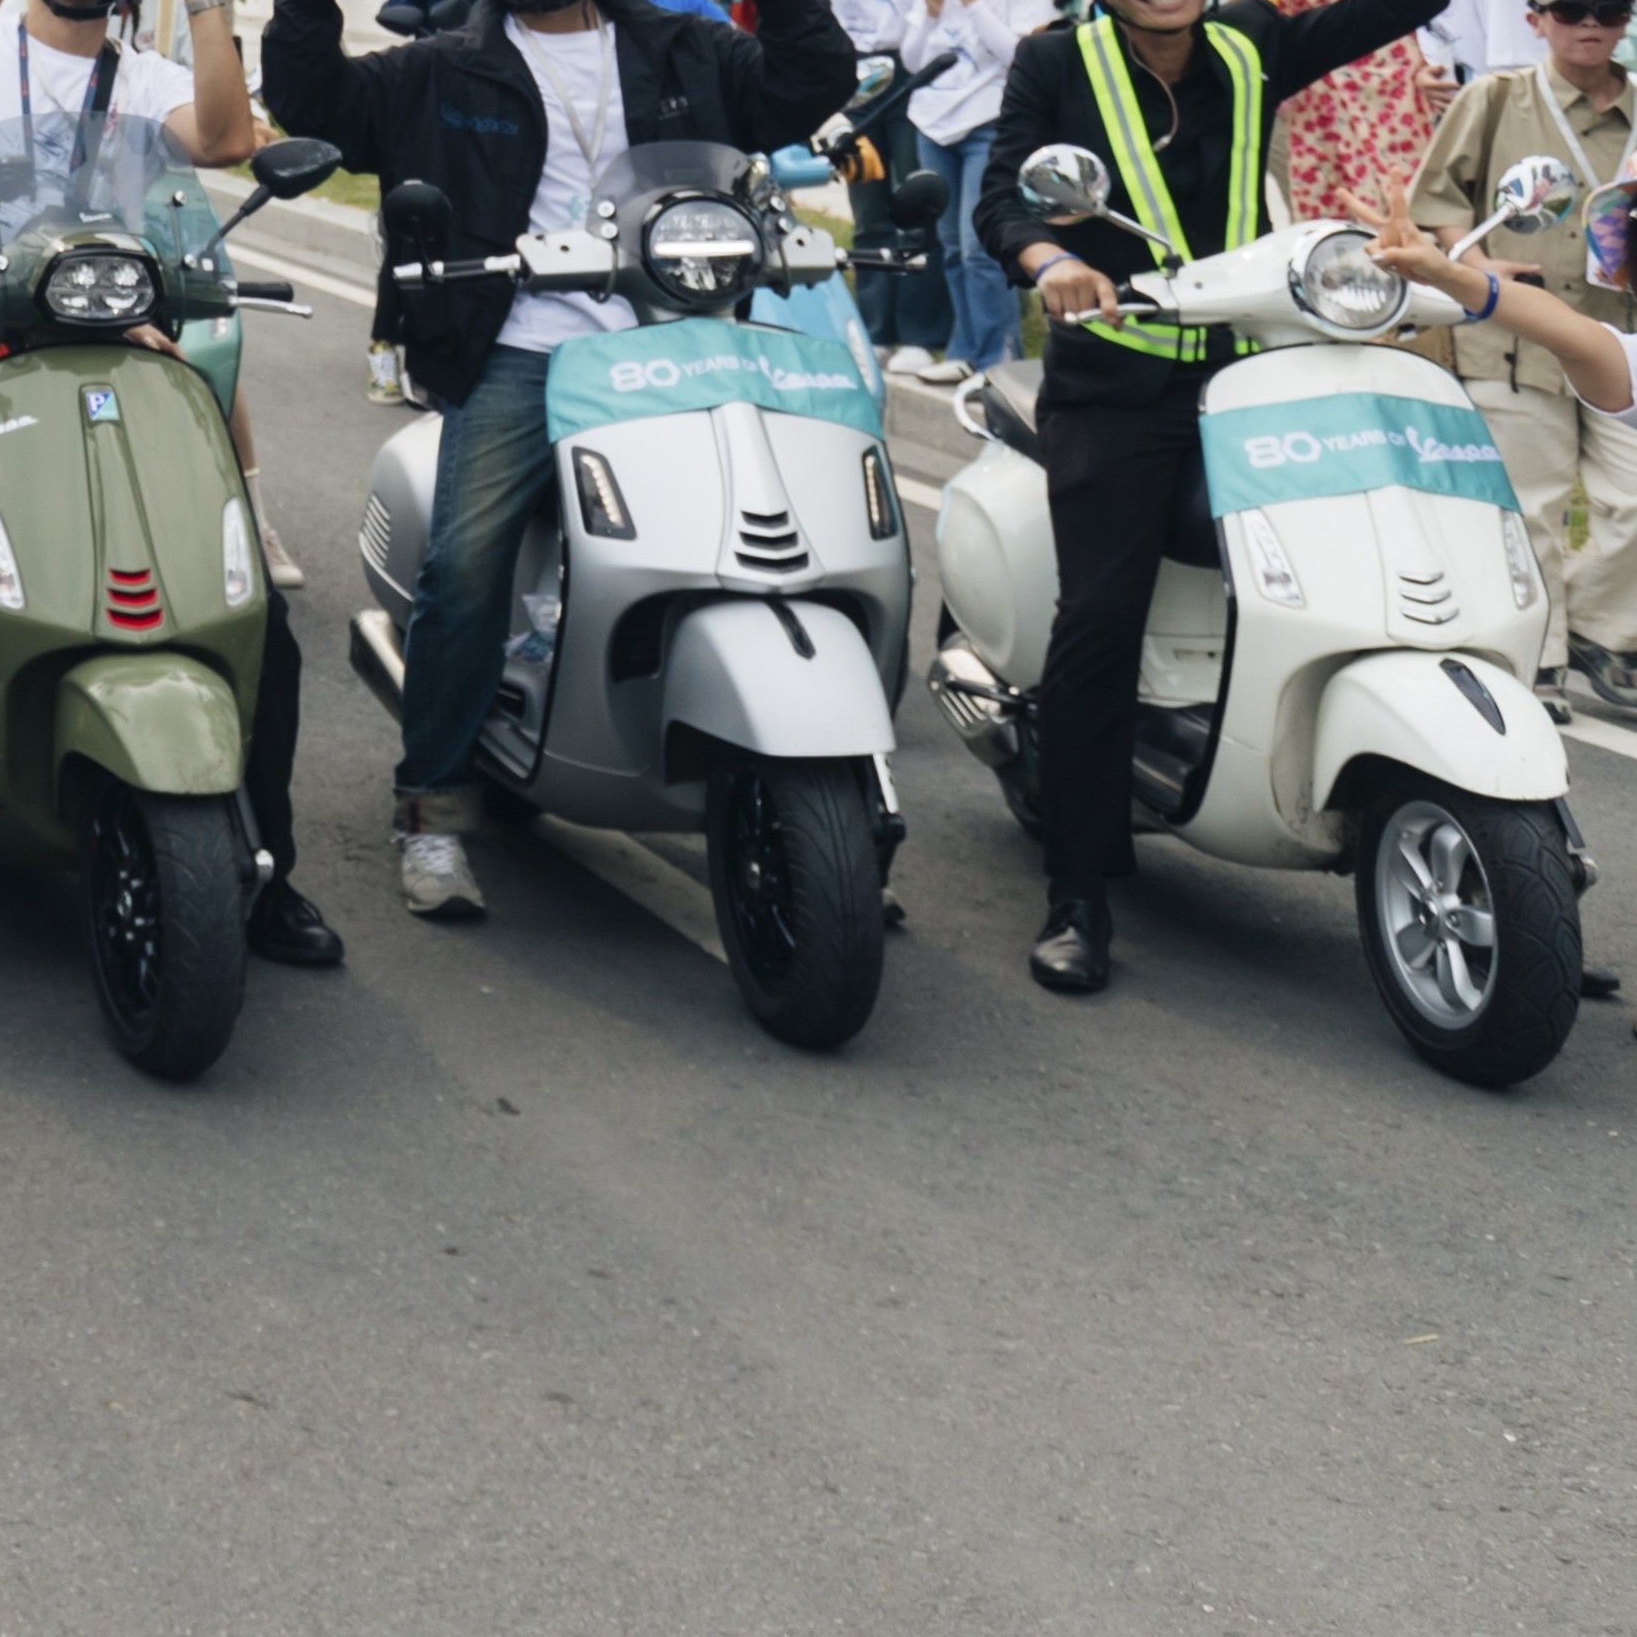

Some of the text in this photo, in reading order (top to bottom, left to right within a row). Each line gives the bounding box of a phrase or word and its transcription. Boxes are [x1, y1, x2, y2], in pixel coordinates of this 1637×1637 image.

[609, 358, 681, 392] 80
[682, 355, 740, 377] YEARS
[758, 354, 858, 390] Vespa
[1244, 430, 1323, 469] 80
[1323, 429, 1387, 452] YEARS
[1405, 425, 1503, 463] Vespa
